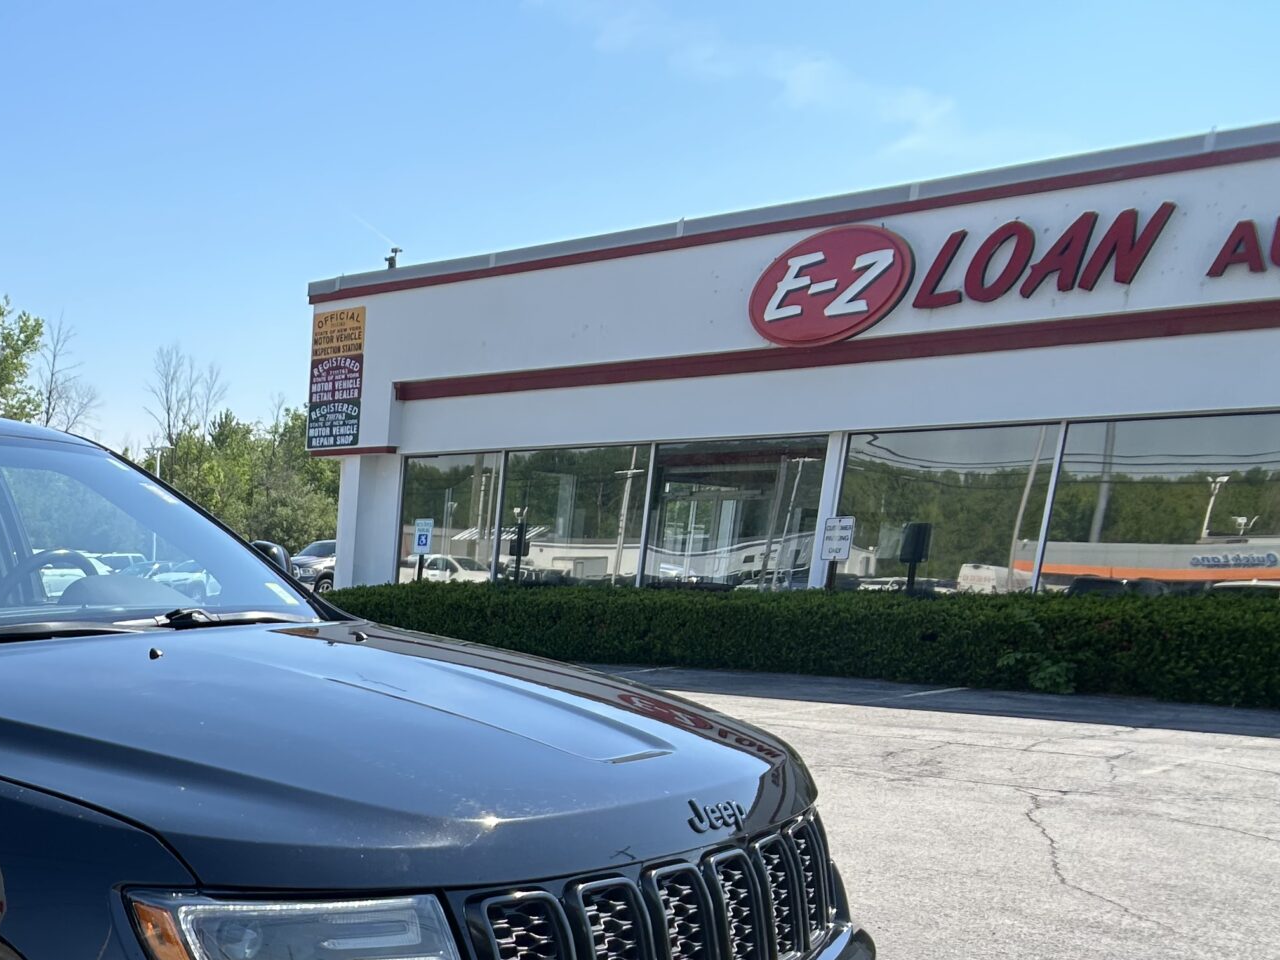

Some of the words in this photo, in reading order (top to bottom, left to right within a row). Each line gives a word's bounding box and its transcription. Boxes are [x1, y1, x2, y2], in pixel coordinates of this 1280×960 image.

[762, 248, 895, 323] E-Z
[912, 201, 1177, 309] LOAN
[317, 311, 361, 329] OFFICIAL
[314, 335, 334, 346] MOTOR
[336, 331, 362, 343] VEHICLE
[313, 345, 341, 356] INSPECTION
[342, 342, 362, 353] STATION
[312, 356, 360, 377] REGISTERED
[311, 381, 333, 392] MOTOR
[334, 378, 361, 390] VEHICLE
[312, 391, 333, 402] RETAIL
[334, 388, 359, 400] DEALER
[310, 402, 359, 421] REGISTERED
[309, 427, 330, 437] MOTOR
[332, 424, 358, 436] VEHICLE
[312, 436, 334, 447] REPAIR
[336, 435, 354, 445] SHOP
[687, 798, 746, 834] Jeep
